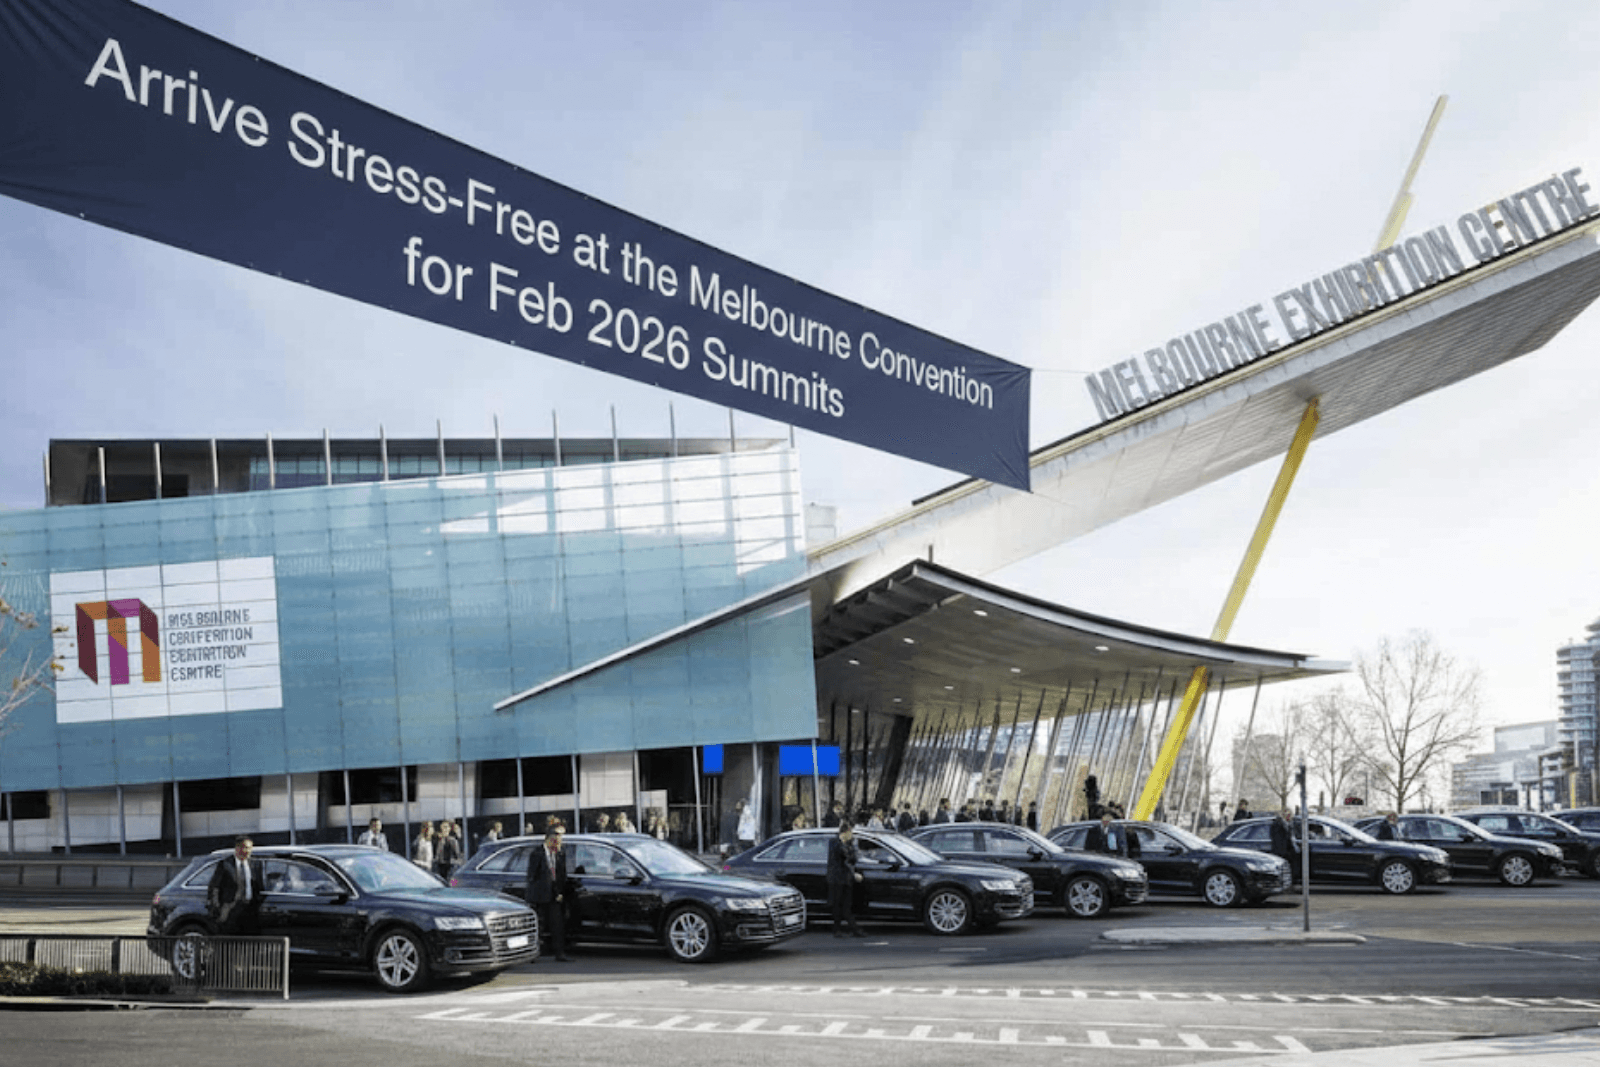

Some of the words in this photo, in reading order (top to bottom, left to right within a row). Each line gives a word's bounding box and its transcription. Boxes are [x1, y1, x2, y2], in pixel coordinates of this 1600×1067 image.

[84, 38, 270, 147] Arrive
[287, 112, 561, 254] Stress-Free
[573, 233, 610, 275] at
[620, 242, 679, 297] the
[689, 264, 852, 360] Melbourne
[859, 325, 994, 410] Convention
[403, 237, 474, 301] for
[489, 263, 573, 333] Feb
[587, 298, 691, 370] 2026
[702, 336, 846, 418] Summits
[1084, 303, 1280, 420] MELBOURNE
[1273, 224, 1464, 340] EXHIBITION
[1457, 166, 1600, 262] CENTRE
